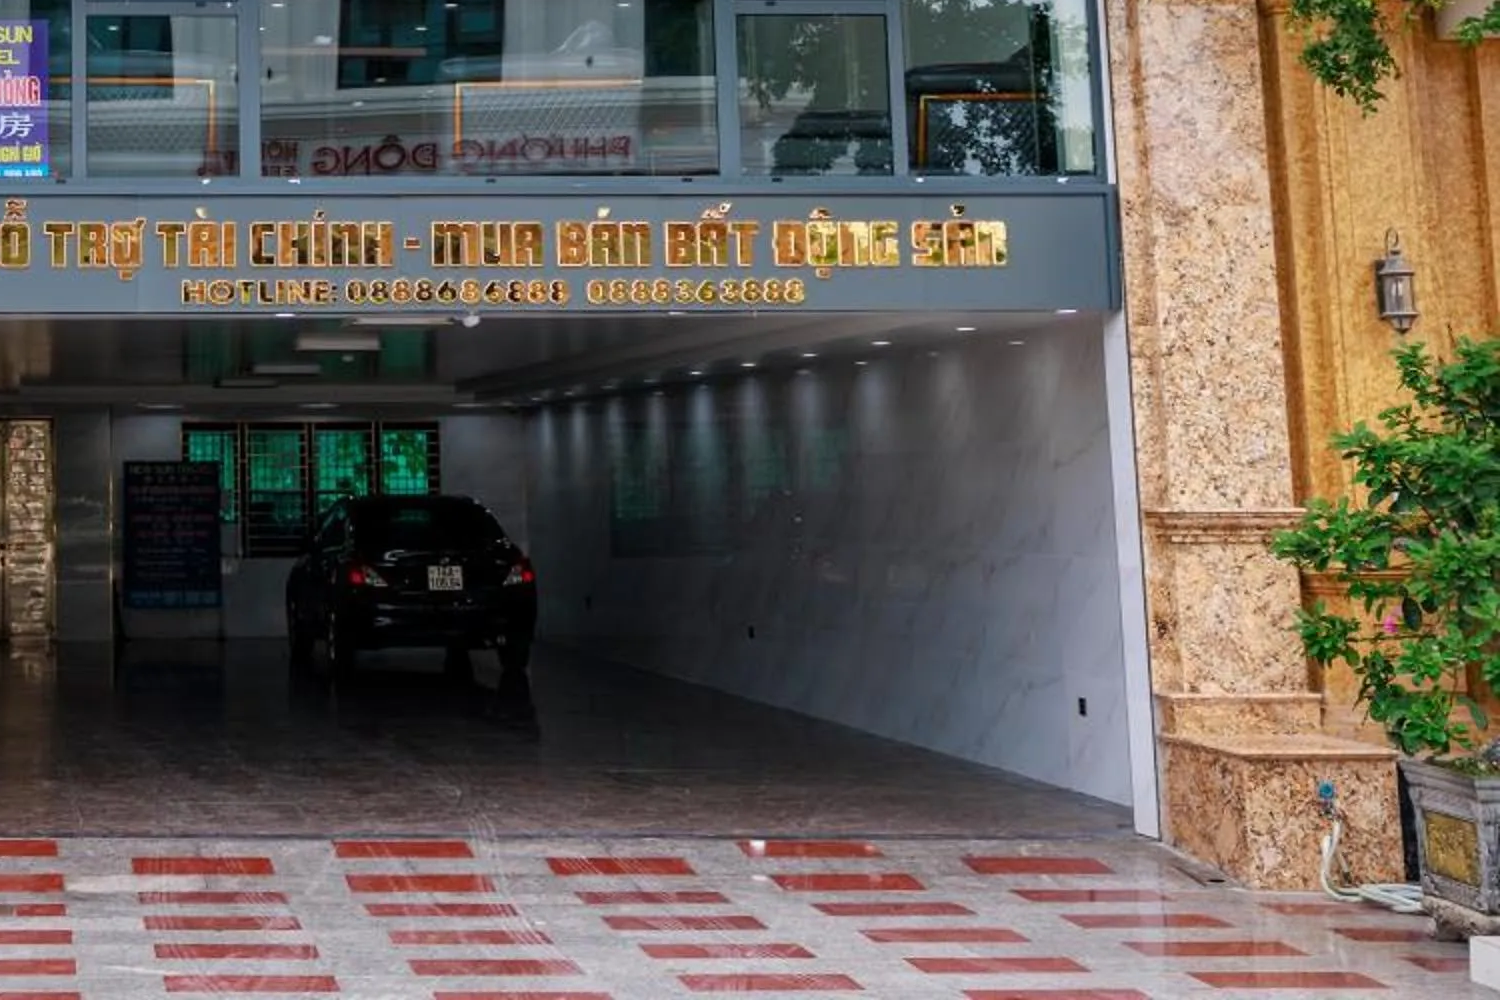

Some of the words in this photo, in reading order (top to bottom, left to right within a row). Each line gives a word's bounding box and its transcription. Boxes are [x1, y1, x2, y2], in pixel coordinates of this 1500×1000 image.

[43, 217, 148, 281] TRỢ
[155, 206, 238, 269] TÀI
[663, 201, 759, 268] BẤT
[181, 278, 338, 306] HOTLINE:
